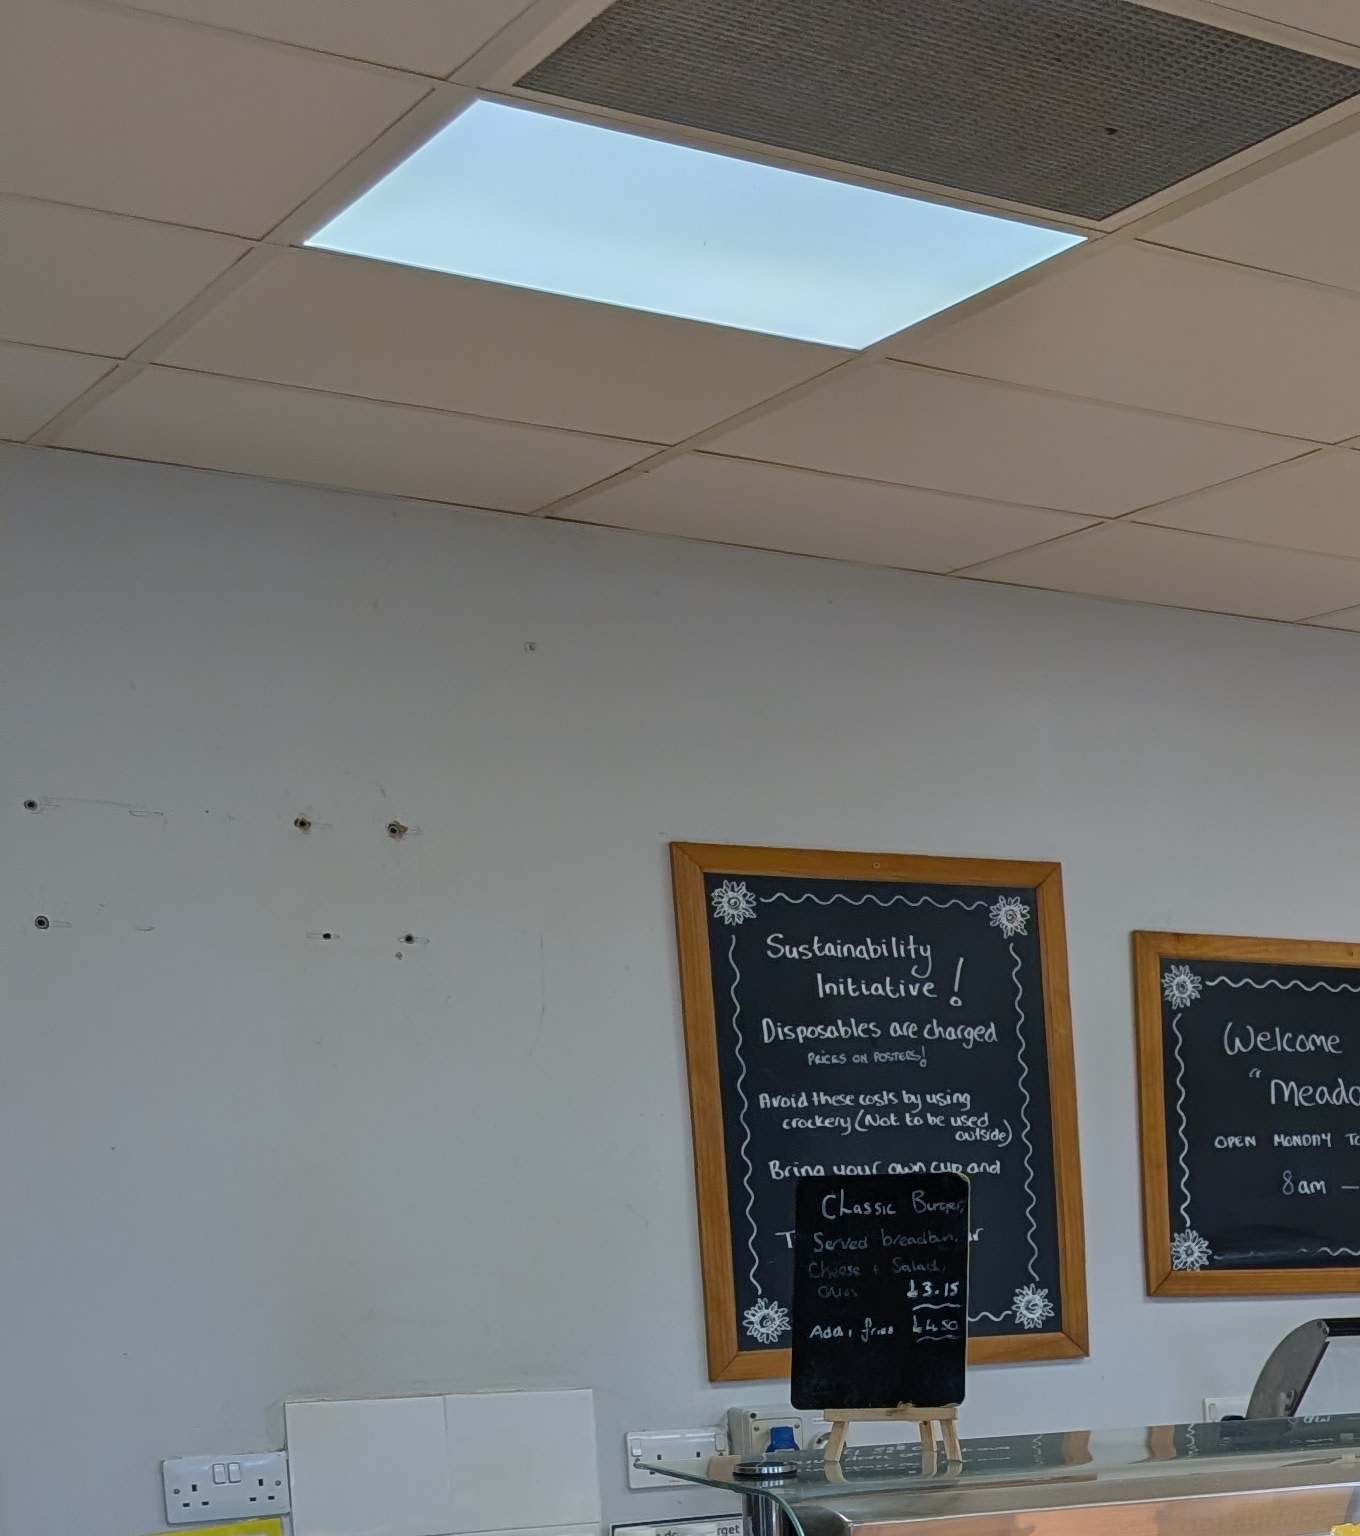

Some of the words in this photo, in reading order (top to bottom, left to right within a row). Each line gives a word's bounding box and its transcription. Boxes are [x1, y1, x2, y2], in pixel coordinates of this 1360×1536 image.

[766, 933, 932, 978] Sustainability
[817, 973, 937, 998] Initiative
[762, 1018, 881, 1043] Disposables
[890, 1021, 918, 1039] are
[923, 1019, 998, 1049] charged
[1224, 1022, 1342, 1055] Welcome
[852, 1053, 868, 1064] ON
[758, 1092, 808, 1109] Avoid
[812, 1092, 854, 1106] these
[859, 1091, 898, 1106] costs
[902, 1090, 922, 1113] by
[926, 1089, 971, 1111] using
[782, 1115, 851, 1136] crockery
[855, 1109, 899, 1131] (Not
[905, 1113, 923, 1126] to
[927, 1111, 945, 1126] be
[950, 1112, 989, 1127] used
[955, 1119, 1012, 1147] outside)
[1214, 1135, 1257, 1149] OPEN
[1273, 1132, 1331, 1147] MONDAY
[888, 1162, 926, 1175] own
[966, 1160, 1001, 1175] and
[813, 1232, 868, 1252] Served
